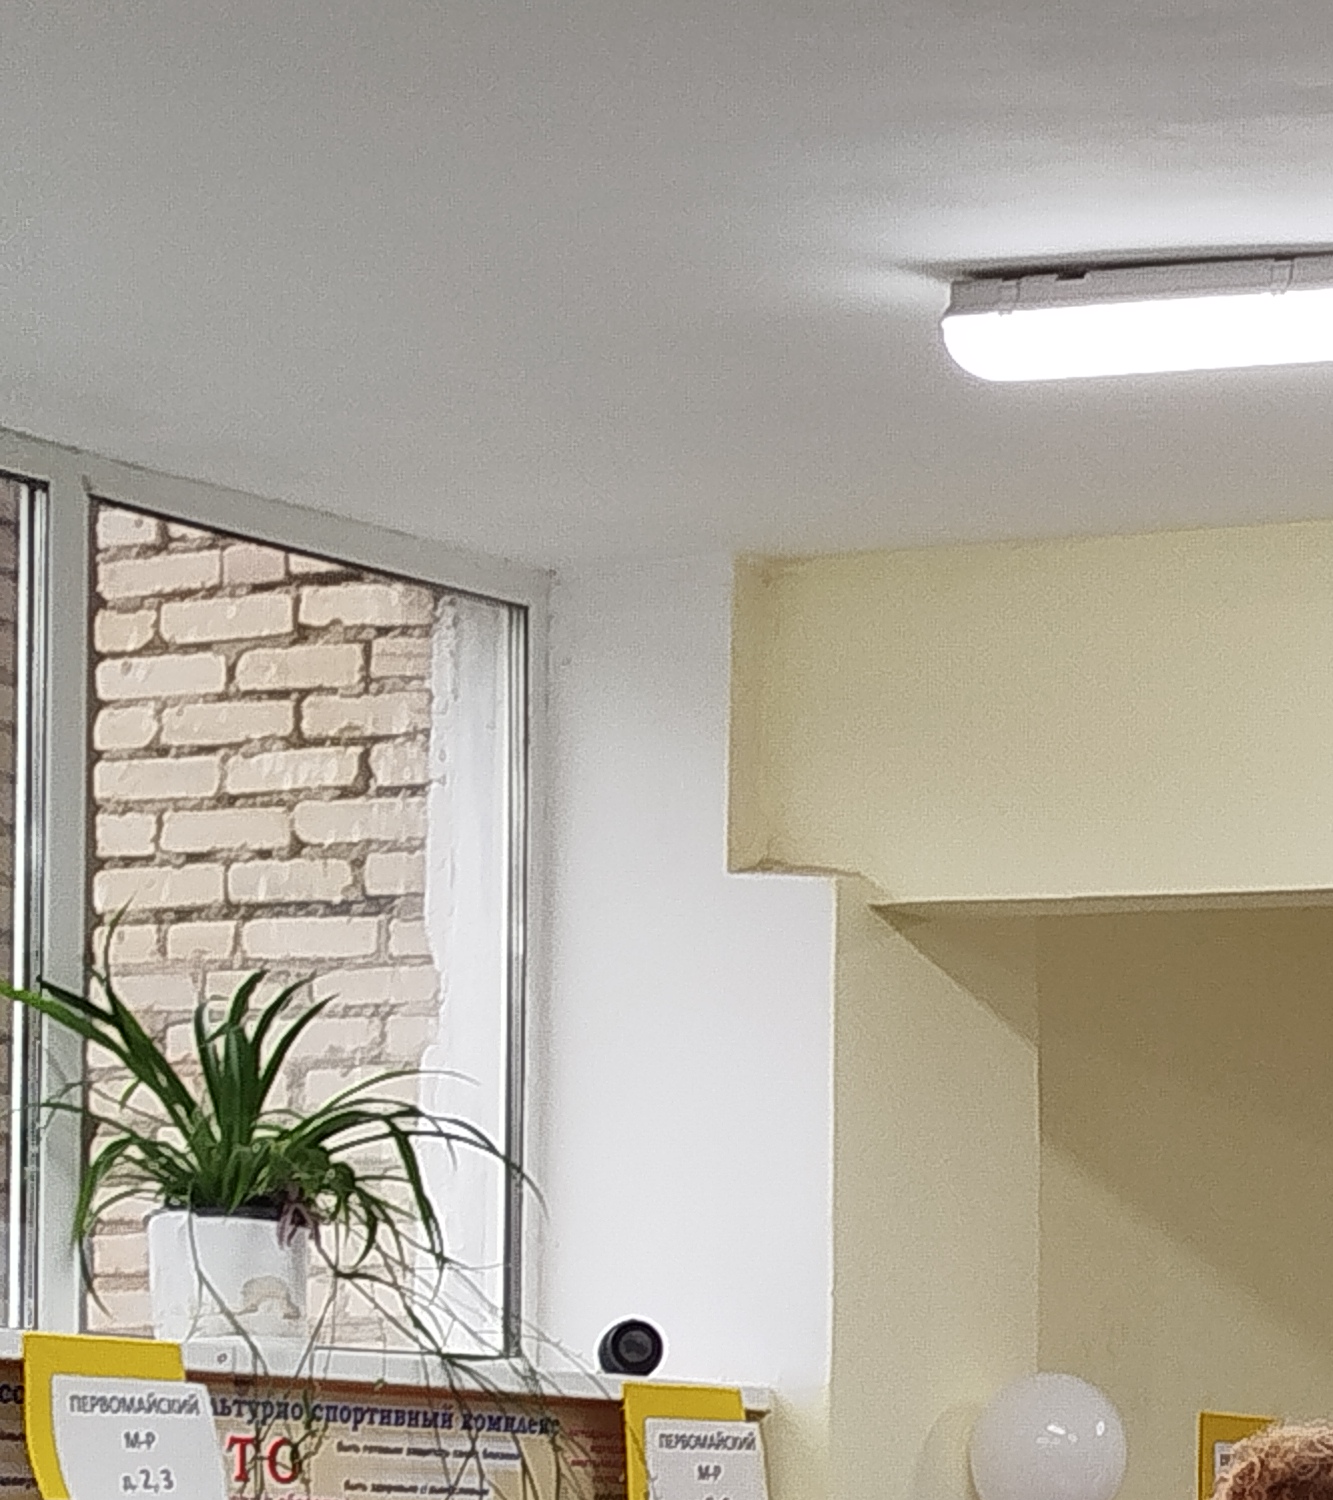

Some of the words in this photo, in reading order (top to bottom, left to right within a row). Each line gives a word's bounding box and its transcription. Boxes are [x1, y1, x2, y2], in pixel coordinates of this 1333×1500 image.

[69, 1391, 201, 1415] ПЕРВОМАЙСКИЙ
[311, 1402, 454, 1431] спортивный
[658, 1431, 757, 1451] ПЕРВОМАЙСКИЙ
[226, 1435, 300, 1484] ТО
